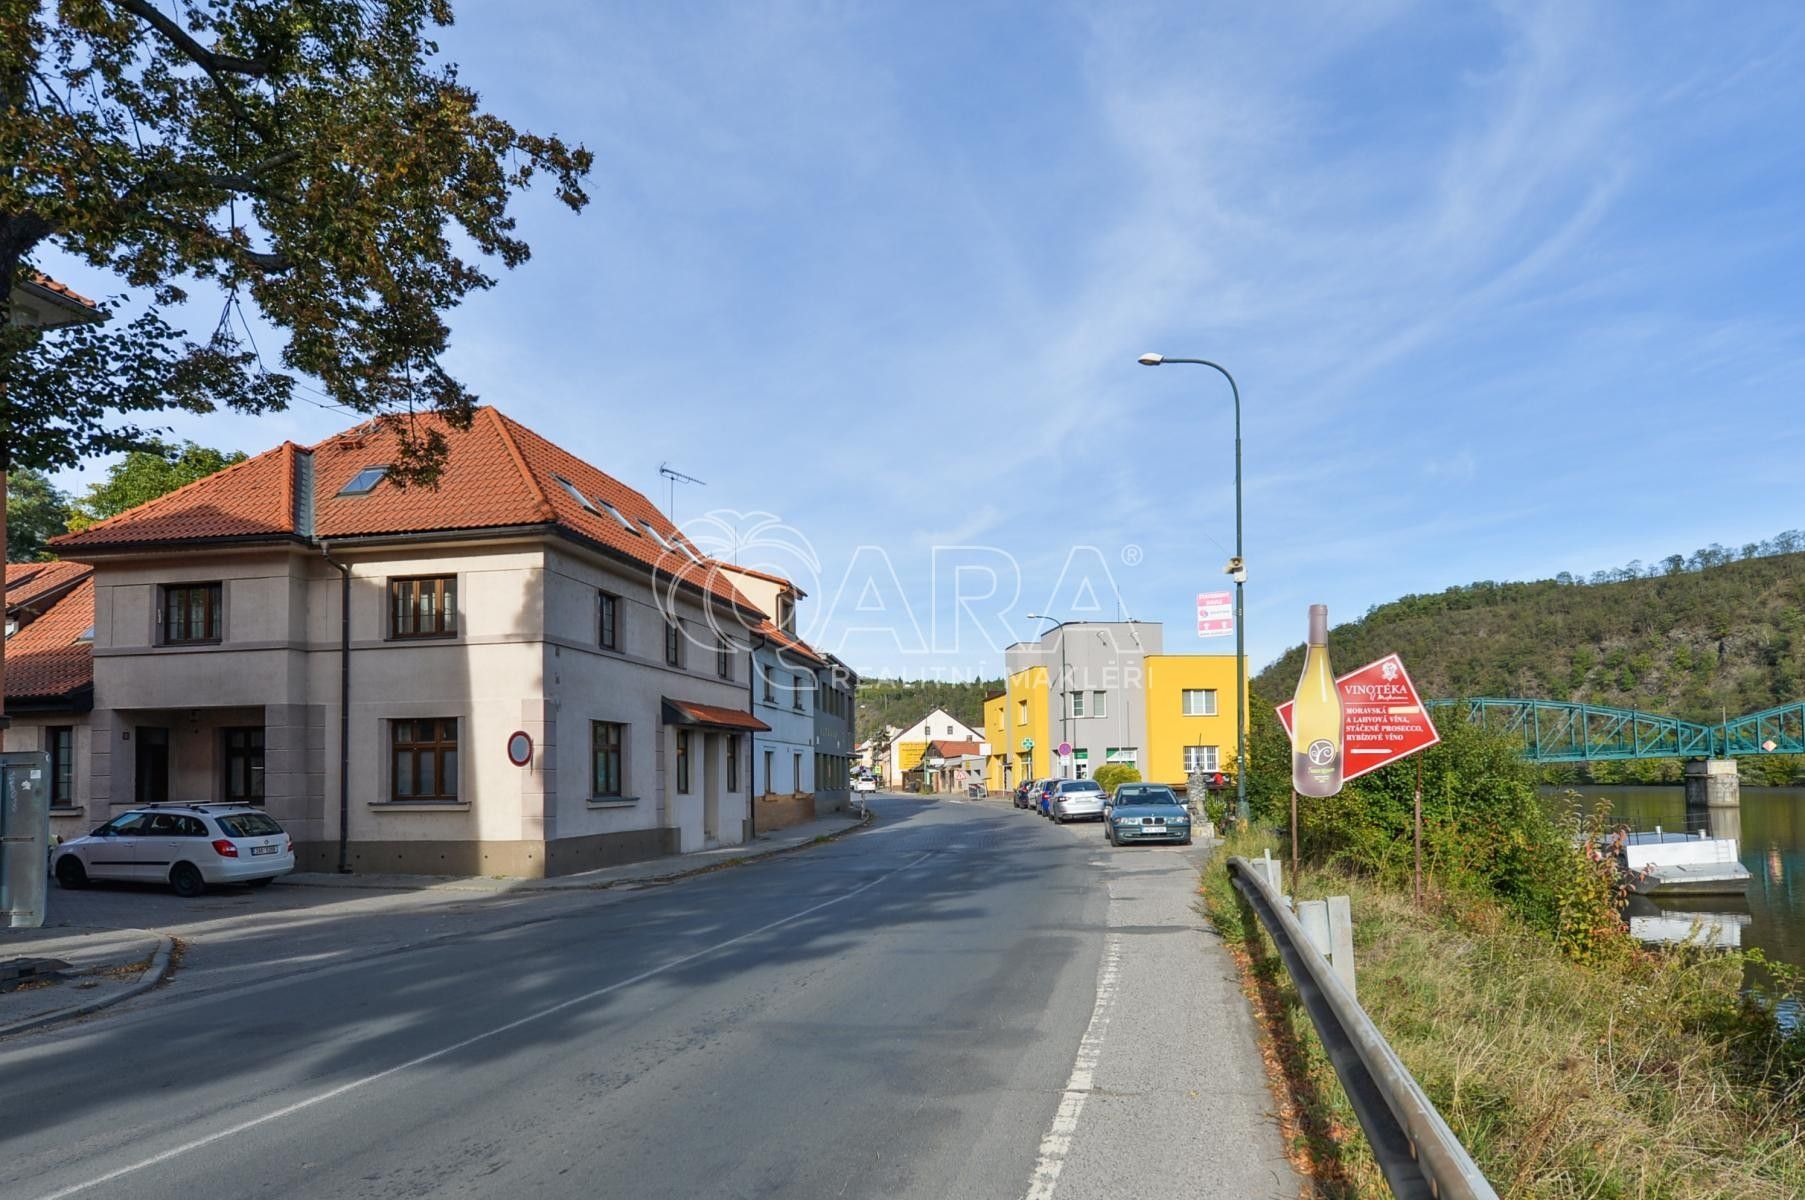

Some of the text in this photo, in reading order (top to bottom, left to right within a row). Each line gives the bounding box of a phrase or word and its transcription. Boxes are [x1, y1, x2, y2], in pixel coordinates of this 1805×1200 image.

[1345, 683, 1407, 694] VINOTÉKA
[1346, 706, 1387, 714] MORAVSKÁ
[1353, 715, 1387, 723] LAHVOVÁ
[1346, 723, 1379, 732] STÁČENÉ
